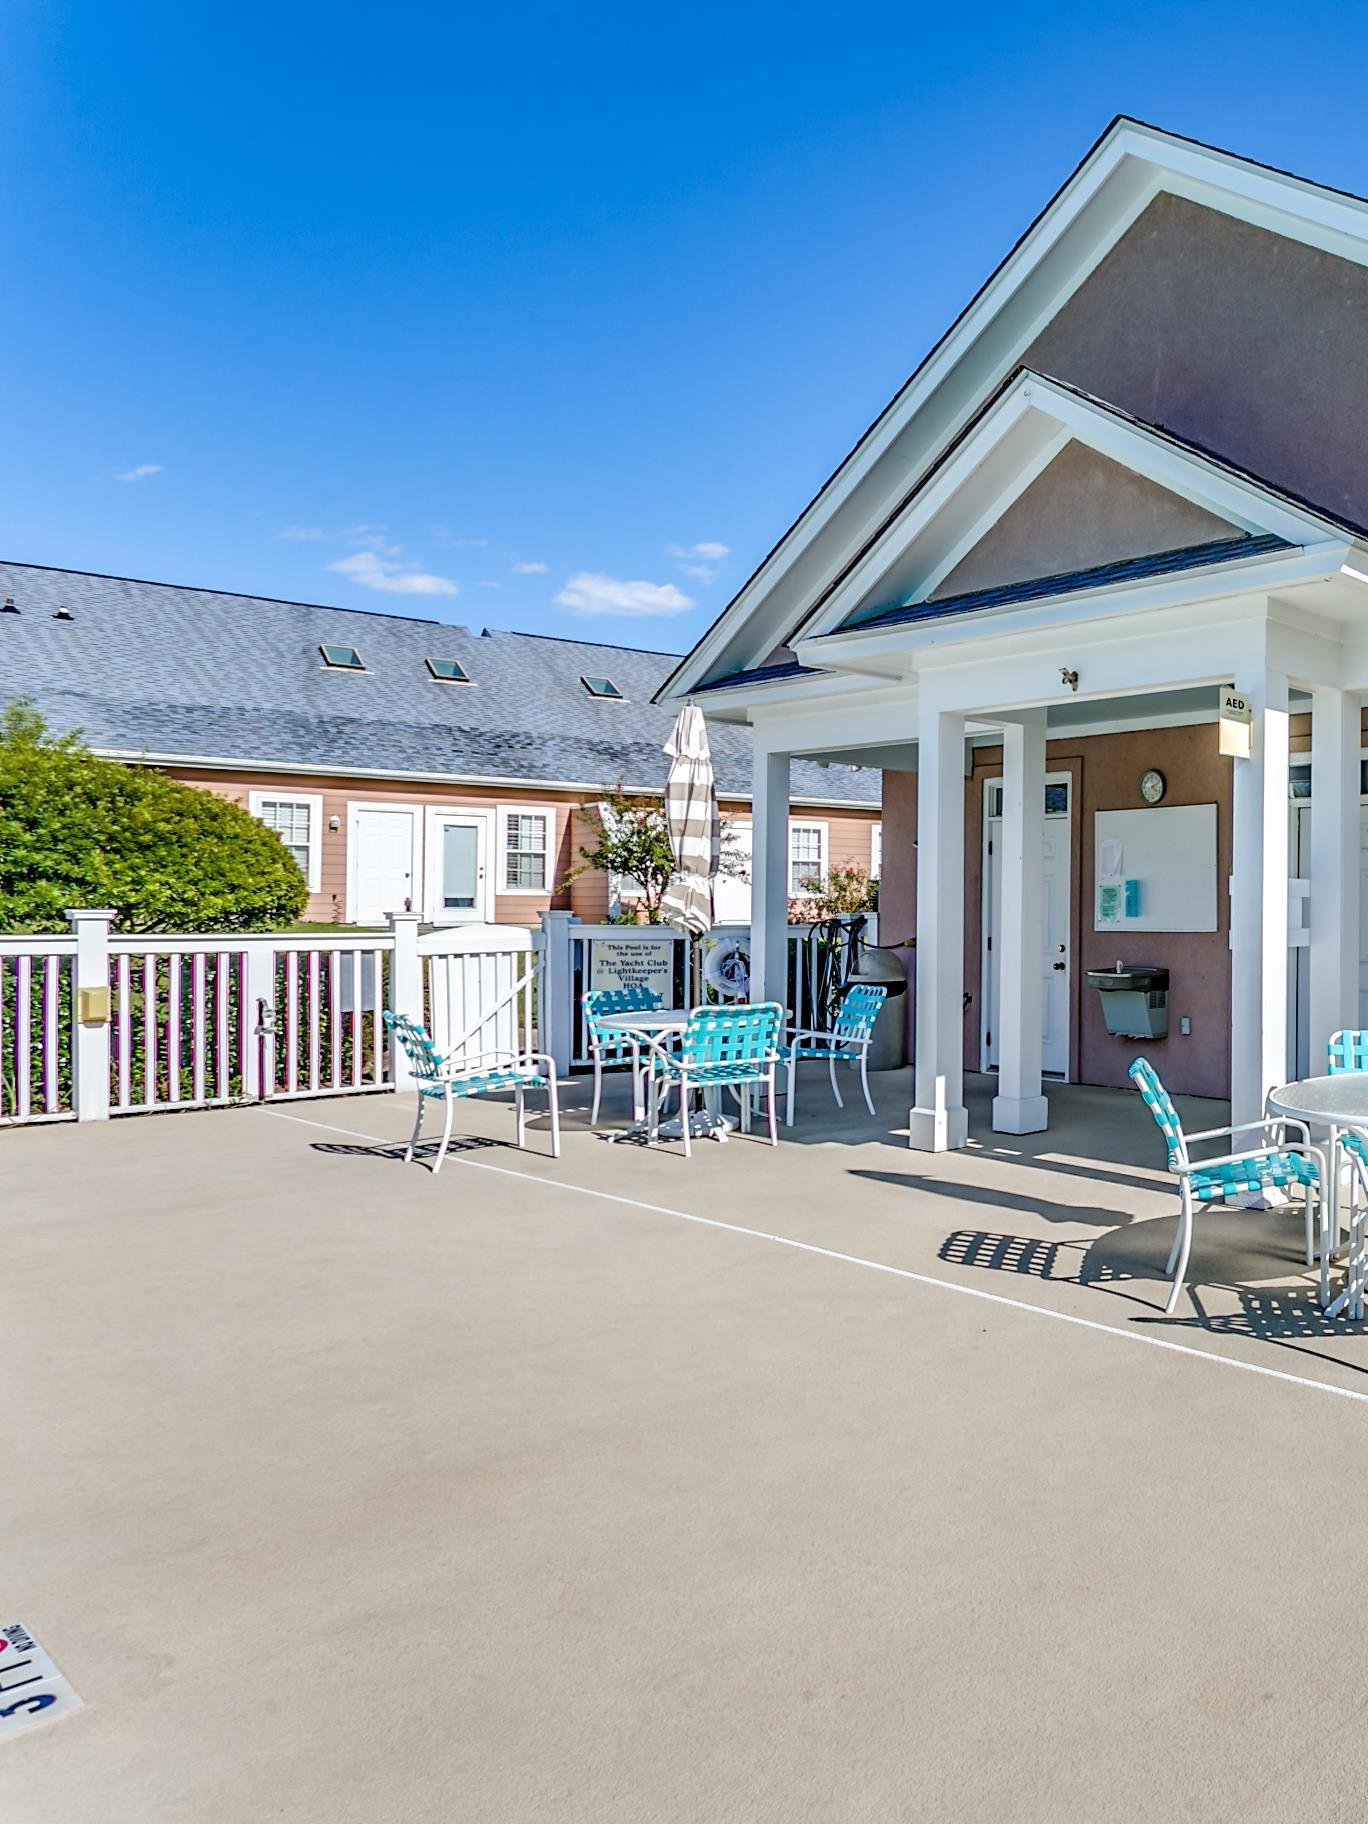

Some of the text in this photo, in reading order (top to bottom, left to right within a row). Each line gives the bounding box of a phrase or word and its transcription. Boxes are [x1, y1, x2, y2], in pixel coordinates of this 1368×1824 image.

[1225, 697, 1245, 710] AED
[600, 959, 668, 967] The Yacht Club
[608, 967, 668, 976] Lightkeeper's
